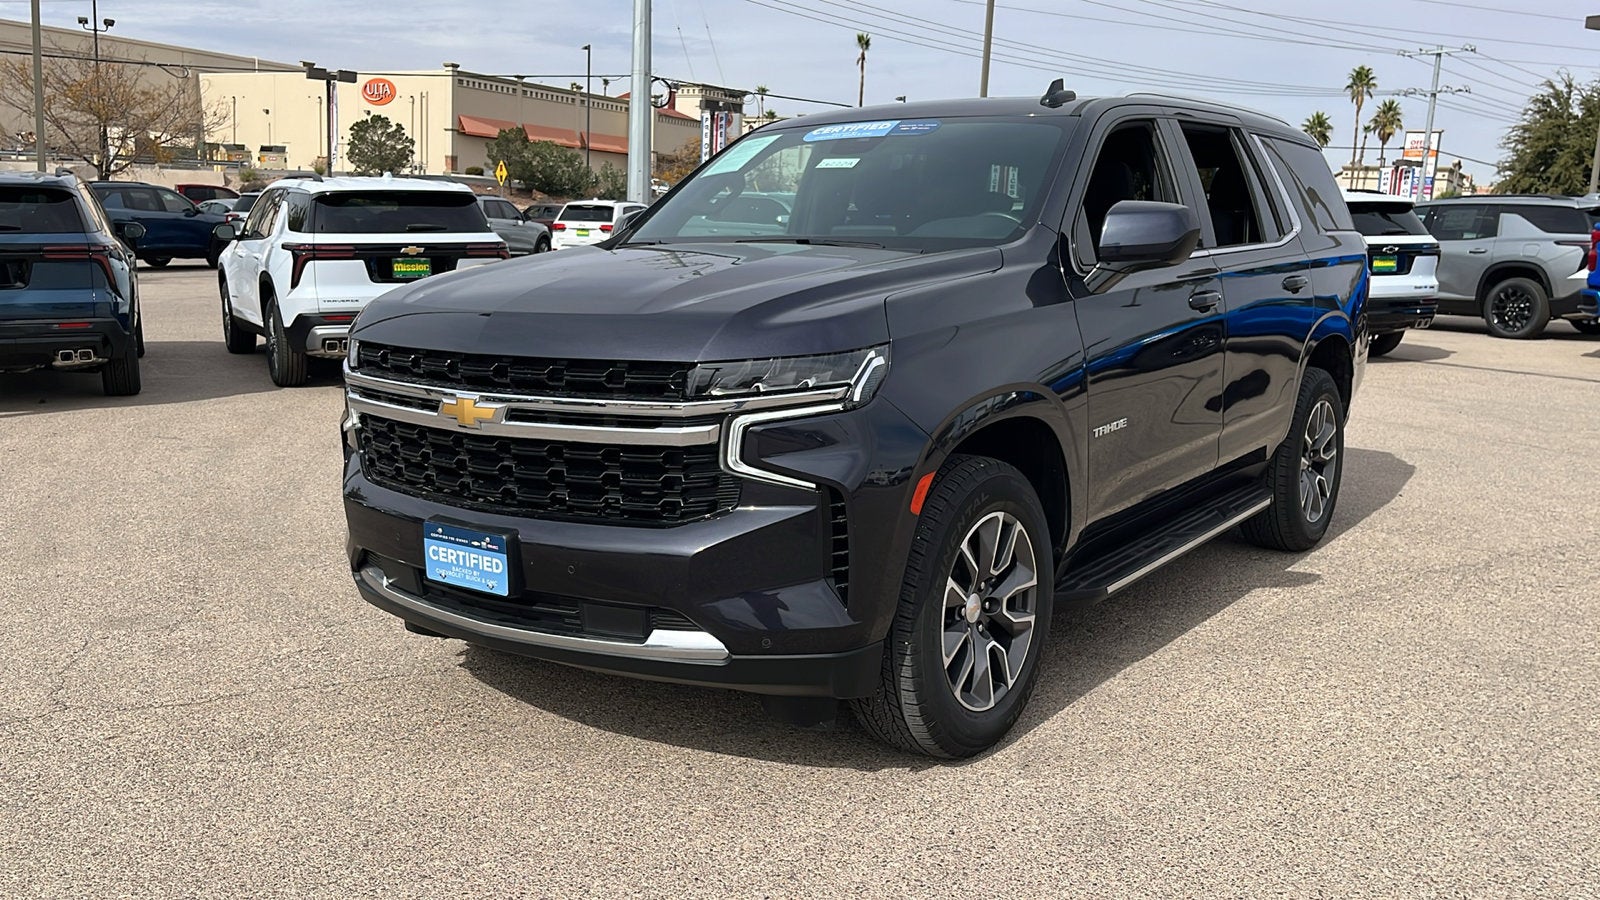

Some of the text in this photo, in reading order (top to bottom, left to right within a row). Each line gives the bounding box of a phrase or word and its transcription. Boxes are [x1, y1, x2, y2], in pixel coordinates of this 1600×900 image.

[366, 82, 391, 95] ULTA
[811, 122, 892, 135] CERTIFIED
[393, 263, 430, 272] Mission
[1092, 417, 1128, 438] TAHOE
[429, 545, 503, 574] CERTIFIED
[435, 567, 464, 578] CHEVROLET
[465, 573, 481, 582] BUICK
[452, 566, 472, 574] BACKED
